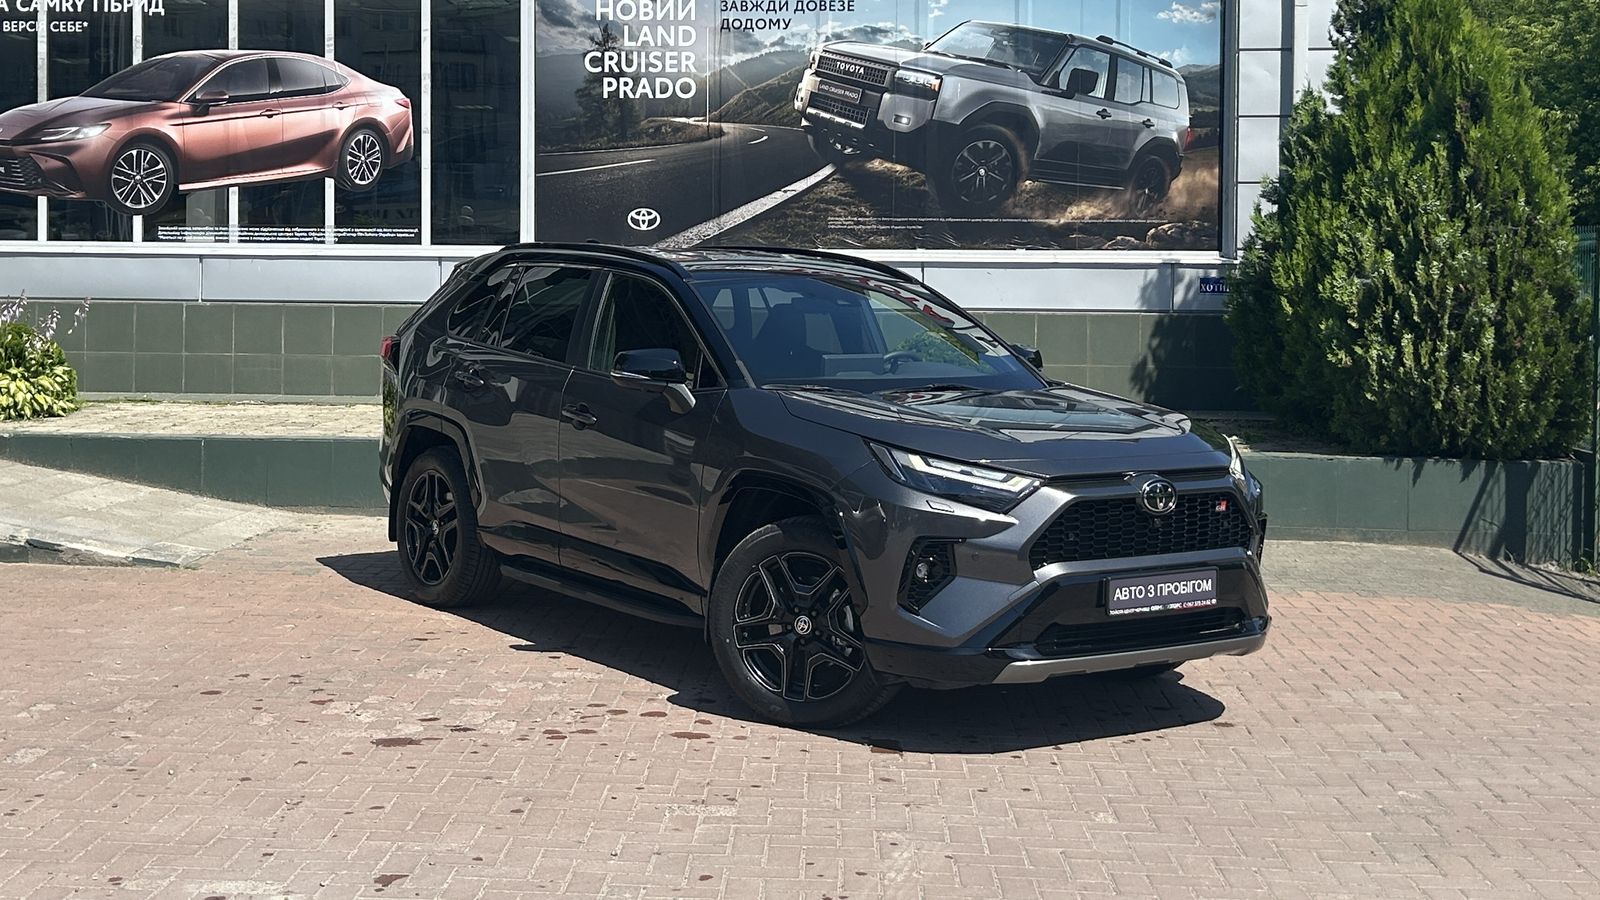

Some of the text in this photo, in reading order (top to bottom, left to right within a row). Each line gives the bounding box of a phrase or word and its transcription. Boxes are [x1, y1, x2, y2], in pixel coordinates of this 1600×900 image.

[720, 0, 855, 14] ЗАВЖДИ ДОВЕЗЕ
[623, 25, 697, 47] LAND
[720, 18, 792, 32] ДОДОМУ
[584, 51, 697, 73] CRUISER
[836, 62, 864, 74] TOYOTA
[602, 77, 697, 99] PRADO
[1113, 585, 1146, 601] АВТО
[1157, 578, 1212, 596] ПРОБІГОМ
